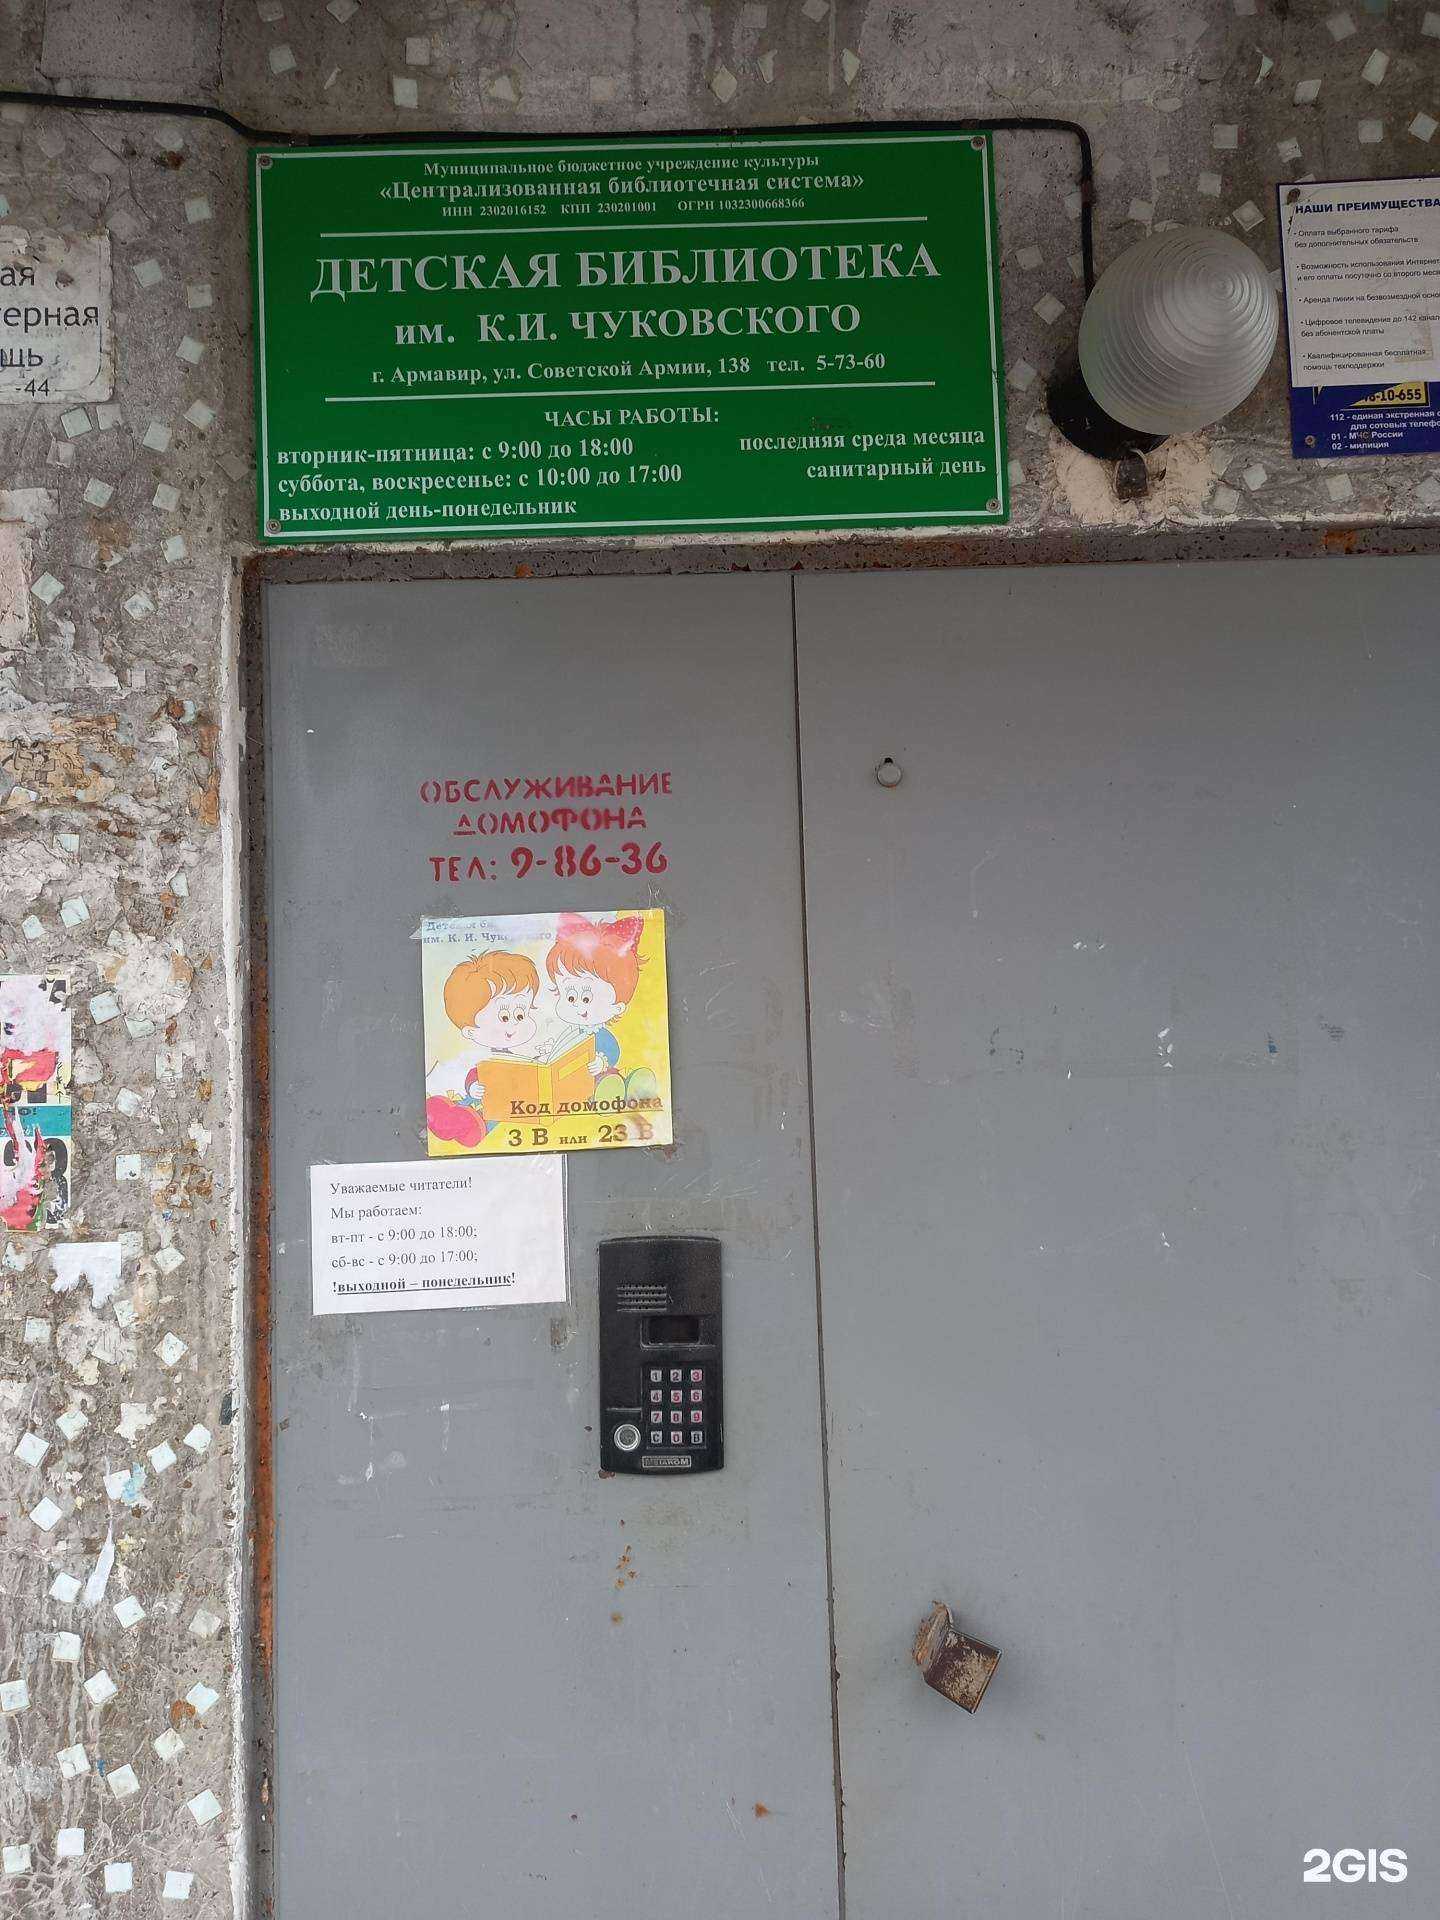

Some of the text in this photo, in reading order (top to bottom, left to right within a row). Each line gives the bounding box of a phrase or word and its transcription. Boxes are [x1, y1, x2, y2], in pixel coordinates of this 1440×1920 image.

[423, 155, 820, 178] Муниципальное бюджетное учреждение культуры
[379, 173, 865, 203] «Централизованная библиотечная система»
[441, 197, 806, 217] ИНН 2302016152 КПП 230201001 ОГРН 1032300668366
[1295, 203, 1333, 215] НАШИ
[1298, 226, 1399, 237] Оплата выбранного тарифа
[1308, 238, 1369, 249] дополнительных
[309, 242, 942, 303] ДЕТСКАЯ БИБЛИОТЕКА
[1300, 262, 1349, 271] Возможность
[1350, 259, 1405, 270] использования
[1316, 273, 1344, 282] оплаты
[1393, 269, 1422, 279] второго
[1303, 294, 1332, 304] Аренда
[1332, 293, 1354, 302] линии
[1366, 291, 1422, 302] безвозмездной
[394, 303, 862, 346] им. К.И. ЧУКОВСКОГО
[1304, 317, 1343, 327] Цифровое
[1344, 316, 1391, 326] телевидение
[1391, 315, 1402, 324] до
[1404, 314, 1417, 322] 142
[1300, 327, 1385, 338] без абонентской платы
[1306, 347, 1426, 360] Квалифицированная бесплатная
[371, 352, 887, 388] г. Армавир, ул. Советской Армии, 138 тел. 5-73-60
[1302, 361, 1385, 373] помощь техподдержки
[543, 406, 720, 428] ЧАСЫ РАБОТЫ:
[1330, 413, 1345, 421] 112
[1351, 412, 1384, 421] единая
[1385, 410, 1435, 419] экстренная
[1331, 433, 1341, 441] 01
[1349, 431, 1370, 440] МЧС
[1371, 430, 1404, 439] России
[1350, 422, 1368, 431] для
[1369, 421, 1408, 429] сотовых
[738, 429, 987, 453] последняя среда месяца
[1349, 441, 1390, 450] милиция
[276, 437, 635, 470] вторник-пятница: с 9:00 до 18:00
[805, 457, 987, 482] санитарный день
[276, 463, 684, 498] суббота, воскресенье: с 10:00 до 17:00
[278, 499, 578, 524] выходной день-понедельник
[418, 771, 673, 804] ОБСЛУЖИВАНИЕ
[452, 805, 648, 836] ДОМОФОНА
[428, 840, 669, 882] ТЕЛ: 9-86-36
[421, 936, 445, 944] им.
[447, 933, 461, 943] К.
[464, 933, 478, 942] И.
[509, 1095, 664, 1117] Код домофона
[508, 1129, 523, 1147] 3
[559, 1133, 588, 1145] или
[597, 1123, 629, 1142] 23
[330, 1176, 473, 1195] Уважаемые читатели!
[330, 1204, 424, 1221] Мы работаем:
[330, 1232, 365, 1244] вт-пт
[377, 1233, 385, 1242] с
[388, 1228, 416, 1241] 9:00
[419, 1229, 436, 1242] до
[439, 1225, 478, 1240] 18:00;
[330, 1254, 365, 1268] сб-вс
[377, 1257, 385, 1266] с
[388, 1252, 417, 1265] 9:00
[419, 1253, 436, 1266] до
[439, 1250, 479, 1265] 17:00;
[332, 1277, 406, 1294] !выходной
[421, 1272, 516, 1291] понедельник!
